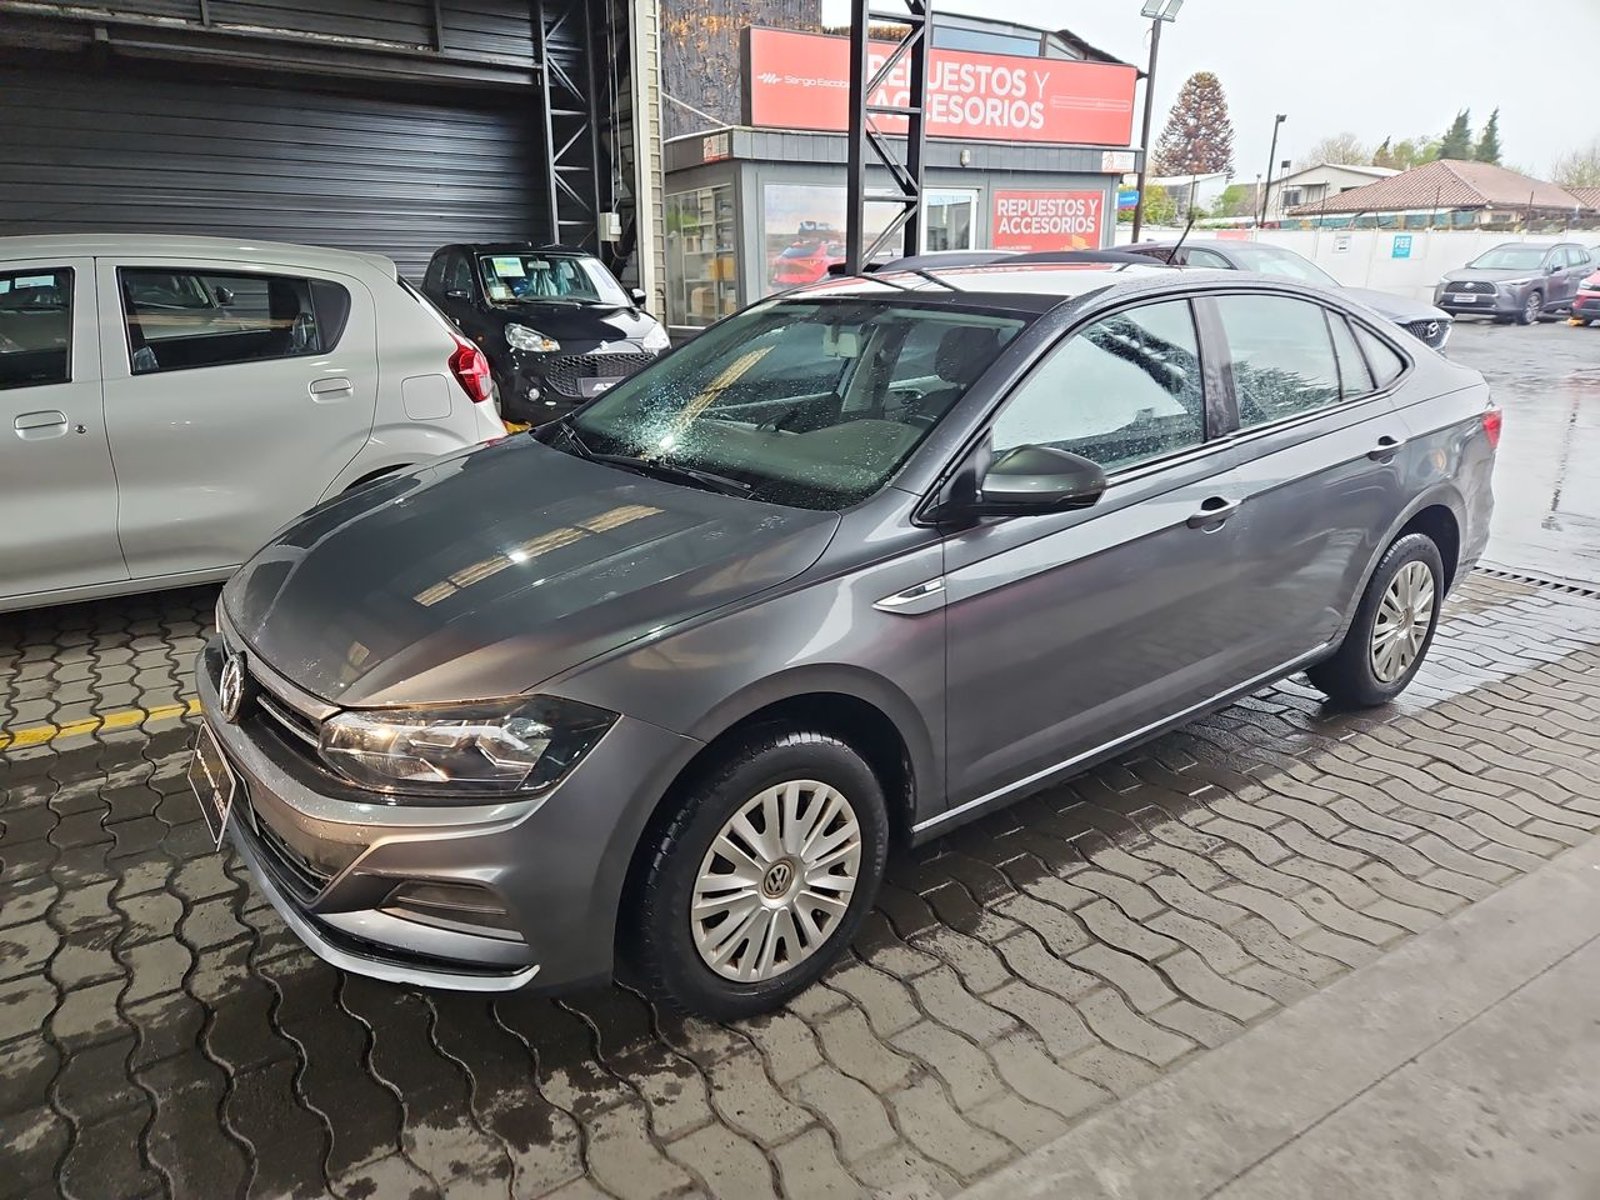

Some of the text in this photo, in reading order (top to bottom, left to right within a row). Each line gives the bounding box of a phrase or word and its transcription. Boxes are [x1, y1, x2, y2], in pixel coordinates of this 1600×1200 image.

[817, 77, 850, 89] Escob
[1033, 71, 1050, 99] Y
[867, 88, 1045, 130] ACESORIOS
[997, 198, 1099, 217] REPUESTOS Y
[998, 216, 1096, 235] ACCESORIOS
[764, 863, 791, 895] VW
